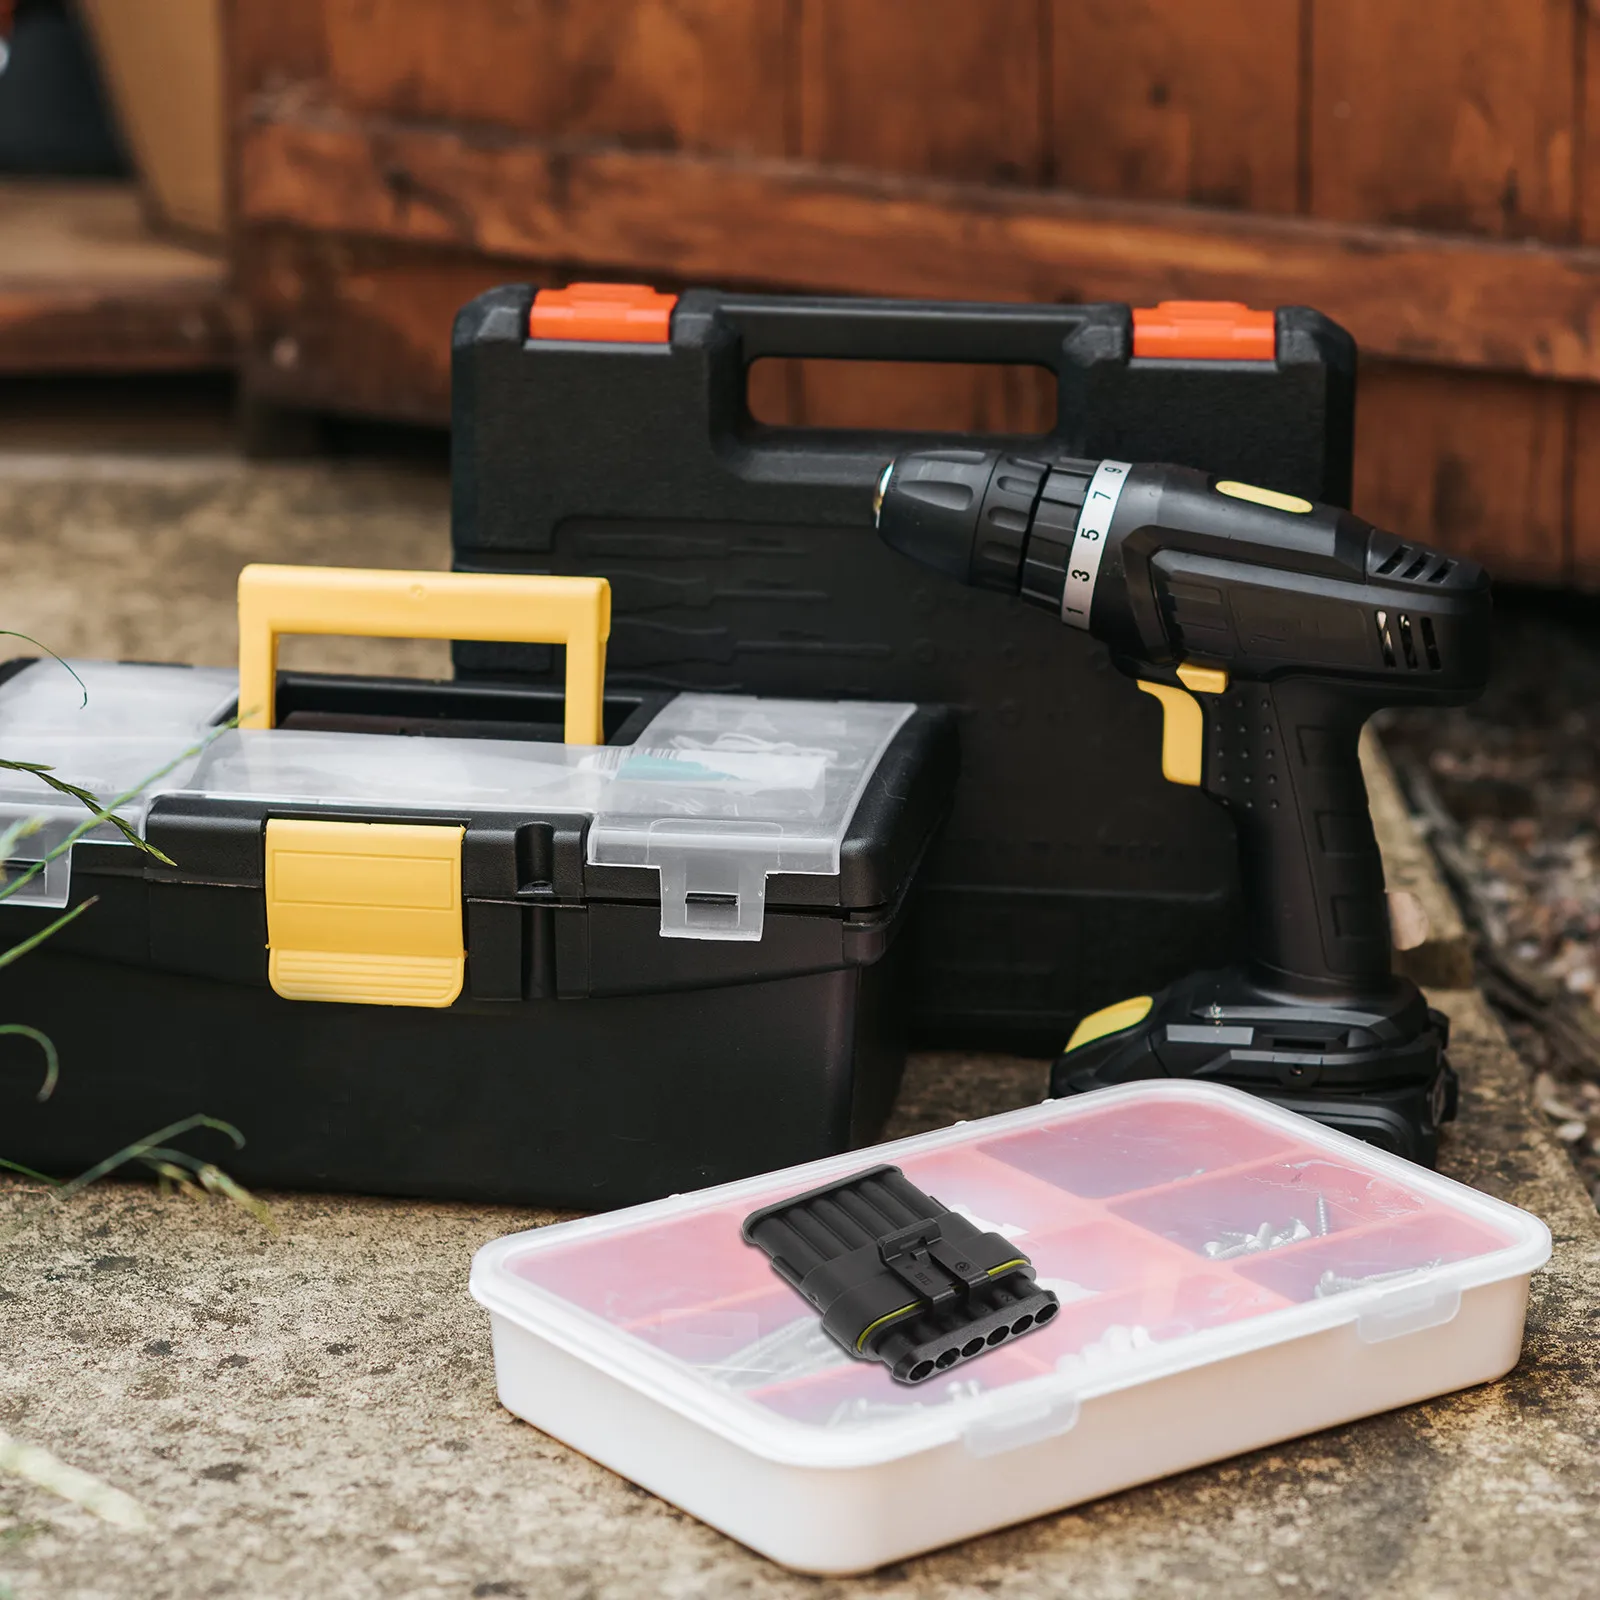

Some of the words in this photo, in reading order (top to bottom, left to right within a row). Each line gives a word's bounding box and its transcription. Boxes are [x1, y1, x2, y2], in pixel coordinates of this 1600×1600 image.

[1104, 466, 1123, 474] 9
[1092, 491, 1111, 500] 7
[1081, 528, 1100, 541] 5
[1071, 569, 1090, 582] 3
[1066, 606, 1084, 615] 1
